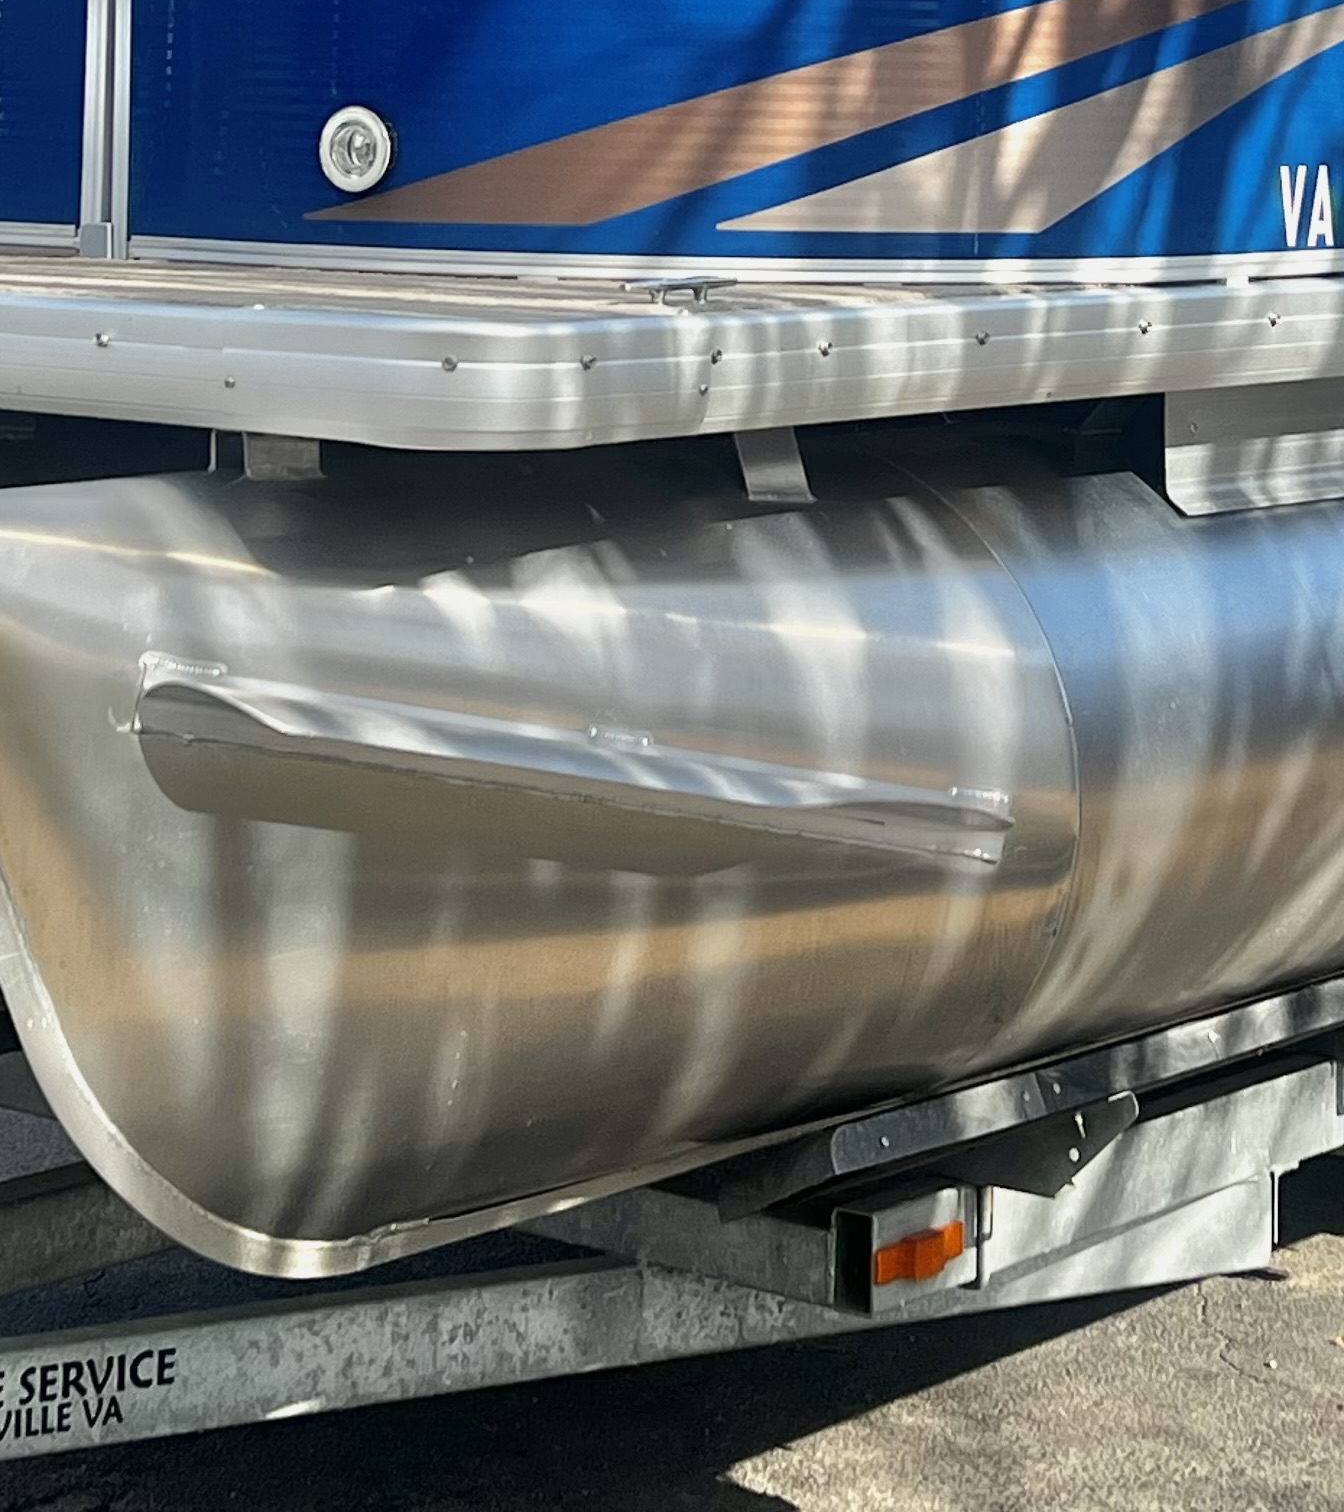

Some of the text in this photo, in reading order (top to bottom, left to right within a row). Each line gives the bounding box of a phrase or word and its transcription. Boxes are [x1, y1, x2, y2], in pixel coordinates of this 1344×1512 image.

[1279, 163, 1335, 248] VA
[18, 1347, 177, 1406] SERVICE
[82, 1395, 124, 1428] VA
